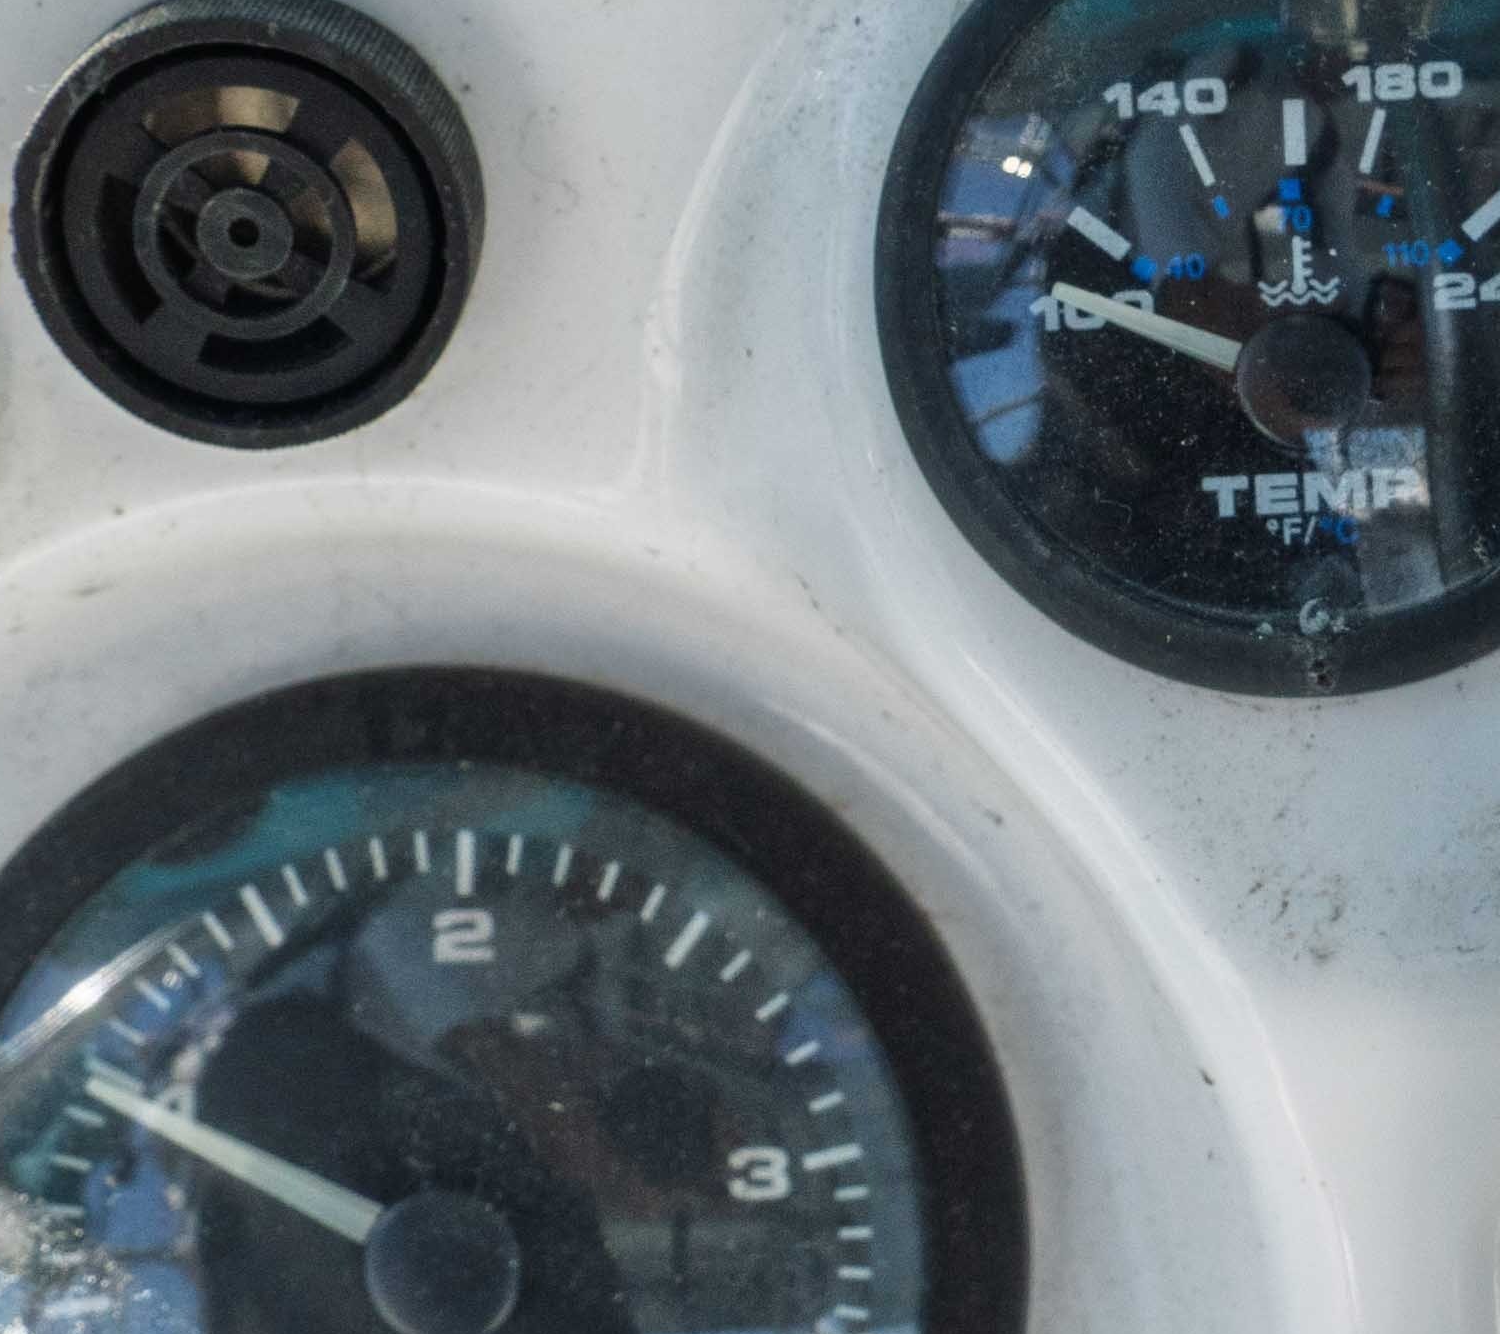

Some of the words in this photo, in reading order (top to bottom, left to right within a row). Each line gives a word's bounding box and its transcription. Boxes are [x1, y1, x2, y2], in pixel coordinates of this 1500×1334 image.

[1104, 75, 1229, 119] 140
[1342, 60, 1464, 103] 180
[1167, 251, 1205, 281] 40
[1382, 239, 1430, 267] 110
[1201, 467, 1426, 518] TEMP
[433, 910, 495, 963] 2
[727, 1151, 792, 1202] 3
